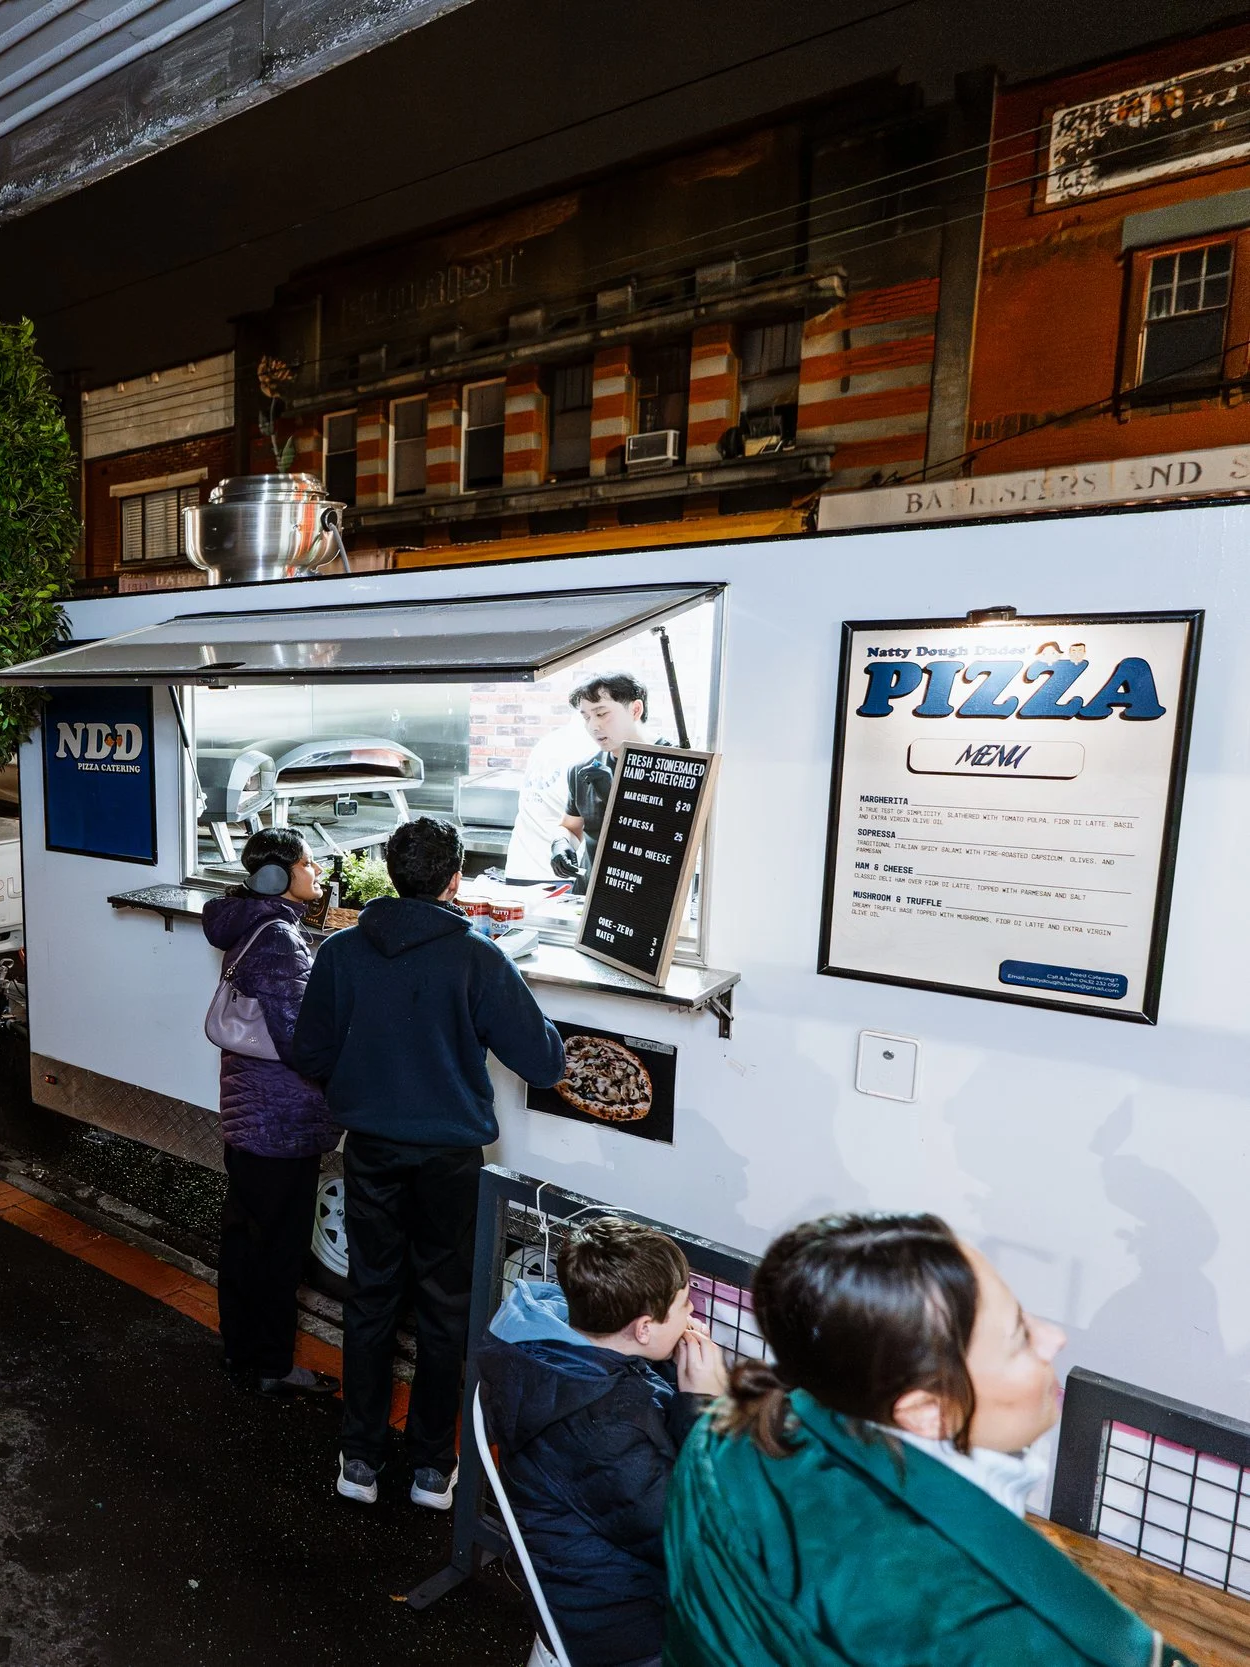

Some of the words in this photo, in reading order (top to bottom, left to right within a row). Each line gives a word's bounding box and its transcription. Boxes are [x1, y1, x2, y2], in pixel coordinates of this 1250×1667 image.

[866, 647, 911, 658] Natty
[916, 645, 968, 658] Dough
[855, 656, 1166, 720] PIZZA
[55, 722, 143, 761] NDD
[626, 753, 653, 768] FRESH
[655, 758, 705, 777] STONEBAKED
[955, 744, 1032, 769] MENU
[78, 762, 99, 772] PIZZA
[101, 763, 140, 774] CATERING
[623, 766, 696, 789] HAND-STRETCHED
[675, 800, 691, 812] $20
[859, 794, 909, 805] MARGHERITA
[890, 815, 910, 823] VIRGIN
[947, 811, 980, 820] SLATHERED
[1114, 821, 1134, 829] BASIL
[618, 816, 654, 832] SOPRESSA
[673, 832, 683, 842] 25
[857, 828, 896, 839] SOPRESSA
[612, 840, 627, 852] HAM
[628, 845, 643, 856] AND
[644, 850, 672, 865] CHEESE
[856, 847, 882, 855] PARMESAN
[857, 840, 890, 849] TRADITIONAL
[894, 842, 918, 850] ITALIAN
[921, 844, 938, 852] SPICY
[941, 846, 962, 854] SALAMI
[983, 850, 1028, 859] FIRE-ROASTED
[606, 866, 643, 885] MUSHROOM
[855, 861, 870, 870] HAM
[874, 863, 879, 871] &
[883, 864, 914, 875] CHEESE
[605, 875, 635, 893] TRUFFLE
[854, 872, 877, 881] CLASSIC
[925, 879, 939, 887] FIOR
[977, 884, 999, 893] TOPPED
[1020, 888, 1052, 897] PARMESAN
[1054, 891, 1067, 899] AND
[1070, 893, 1086, 901] SALT
[852, 890, 892, 902] MUSHROOM
[906, 896, 943, 908] TRUFFLE
[851, 909, 868, 917] OLIVE
[852, 901, 871, 909] CREAMY
[874, 904, 897, 913] TRUFFLE
[916, 908, 937, 917] TOPPED
[1025, 921, 1045, 929] LATTE
[1048, 923, 1060, 931] AND
[1063, 925, 1083, 934] EXTRA
[1086, 927, 1112, 936] VIRGIN
[598, 916, 634, 937] COKE-ZERO
[652, 937, 658, 947] 3
[595, 928, 615, 943] WATER
[649, 948, 655, 957] 3
[1088, 974, 1119, 982] Catering?
